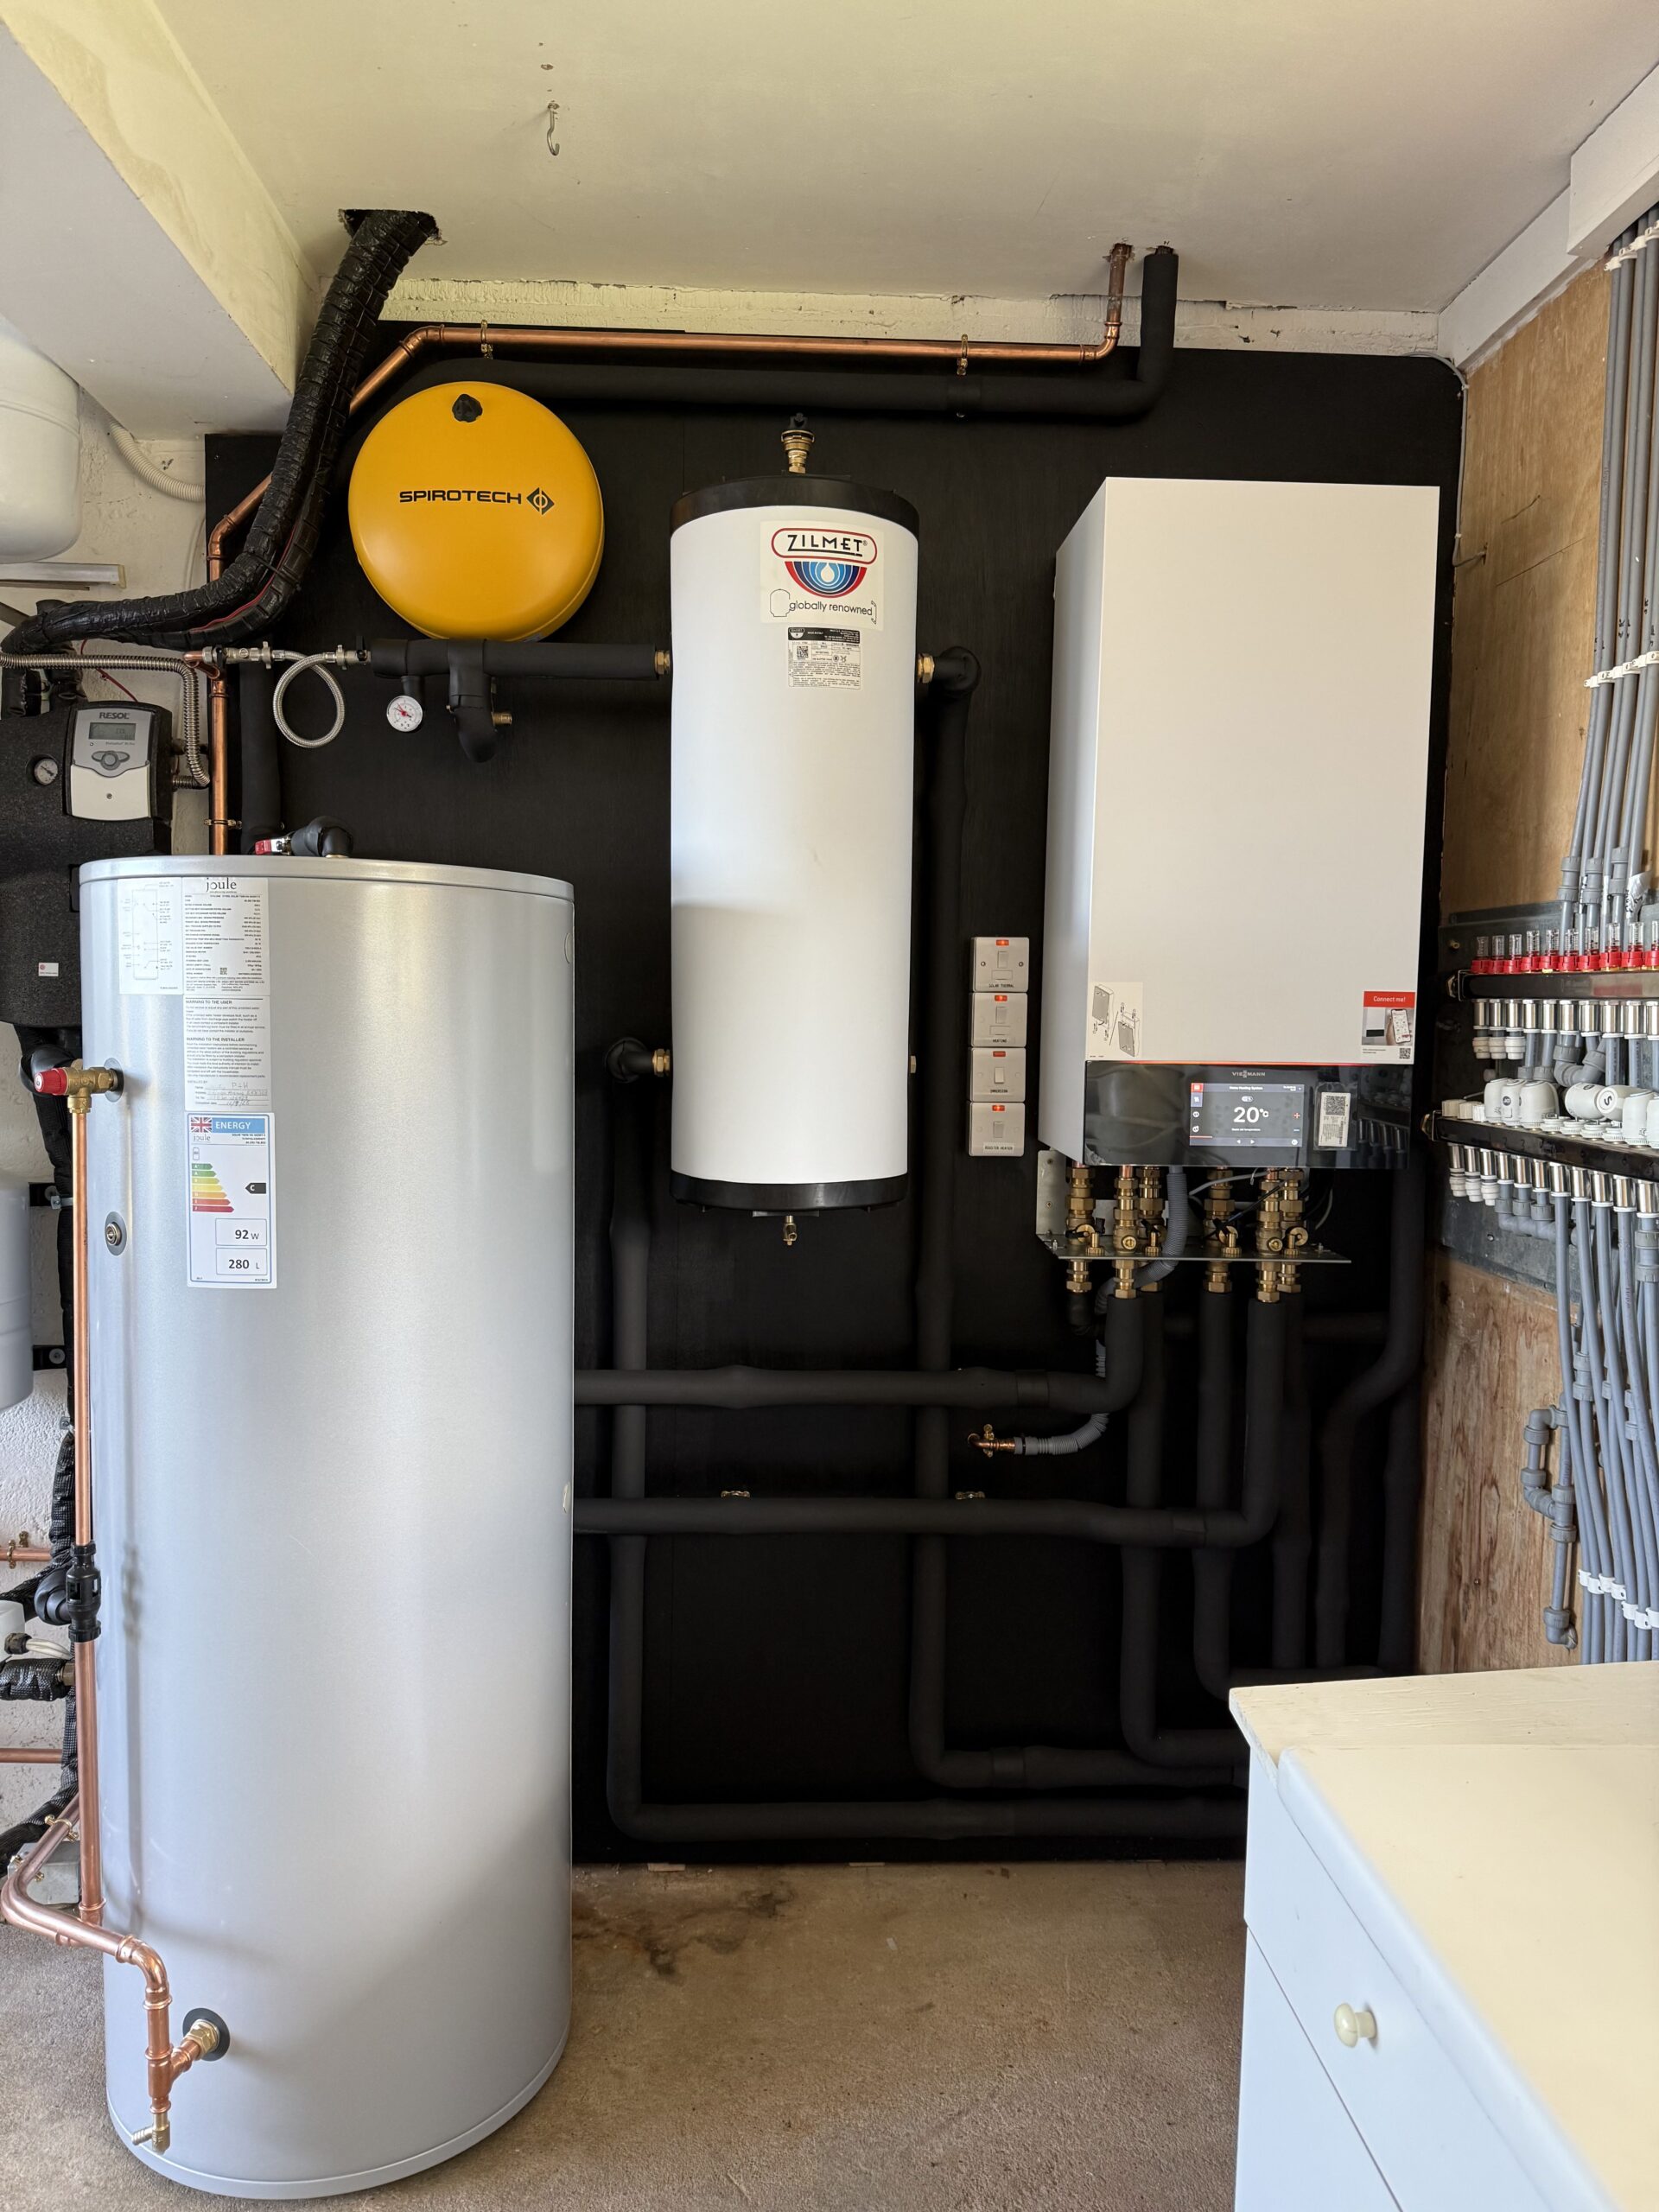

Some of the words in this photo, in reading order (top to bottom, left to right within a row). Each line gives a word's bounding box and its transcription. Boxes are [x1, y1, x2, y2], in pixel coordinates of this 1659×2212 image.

[399, 489, 522, 505] SPIROTECH
[789, 601, 827, 612] globally
[829, 602, 873, 616] renowned
[99, 711, 130, 720] RESOL
[206, 877, 237, 892] joule
[215, 1121, 251, 1129] ENERGY
[234, 1230, 249, 1240] 92
[228, 1259, 250, 1269] 280
